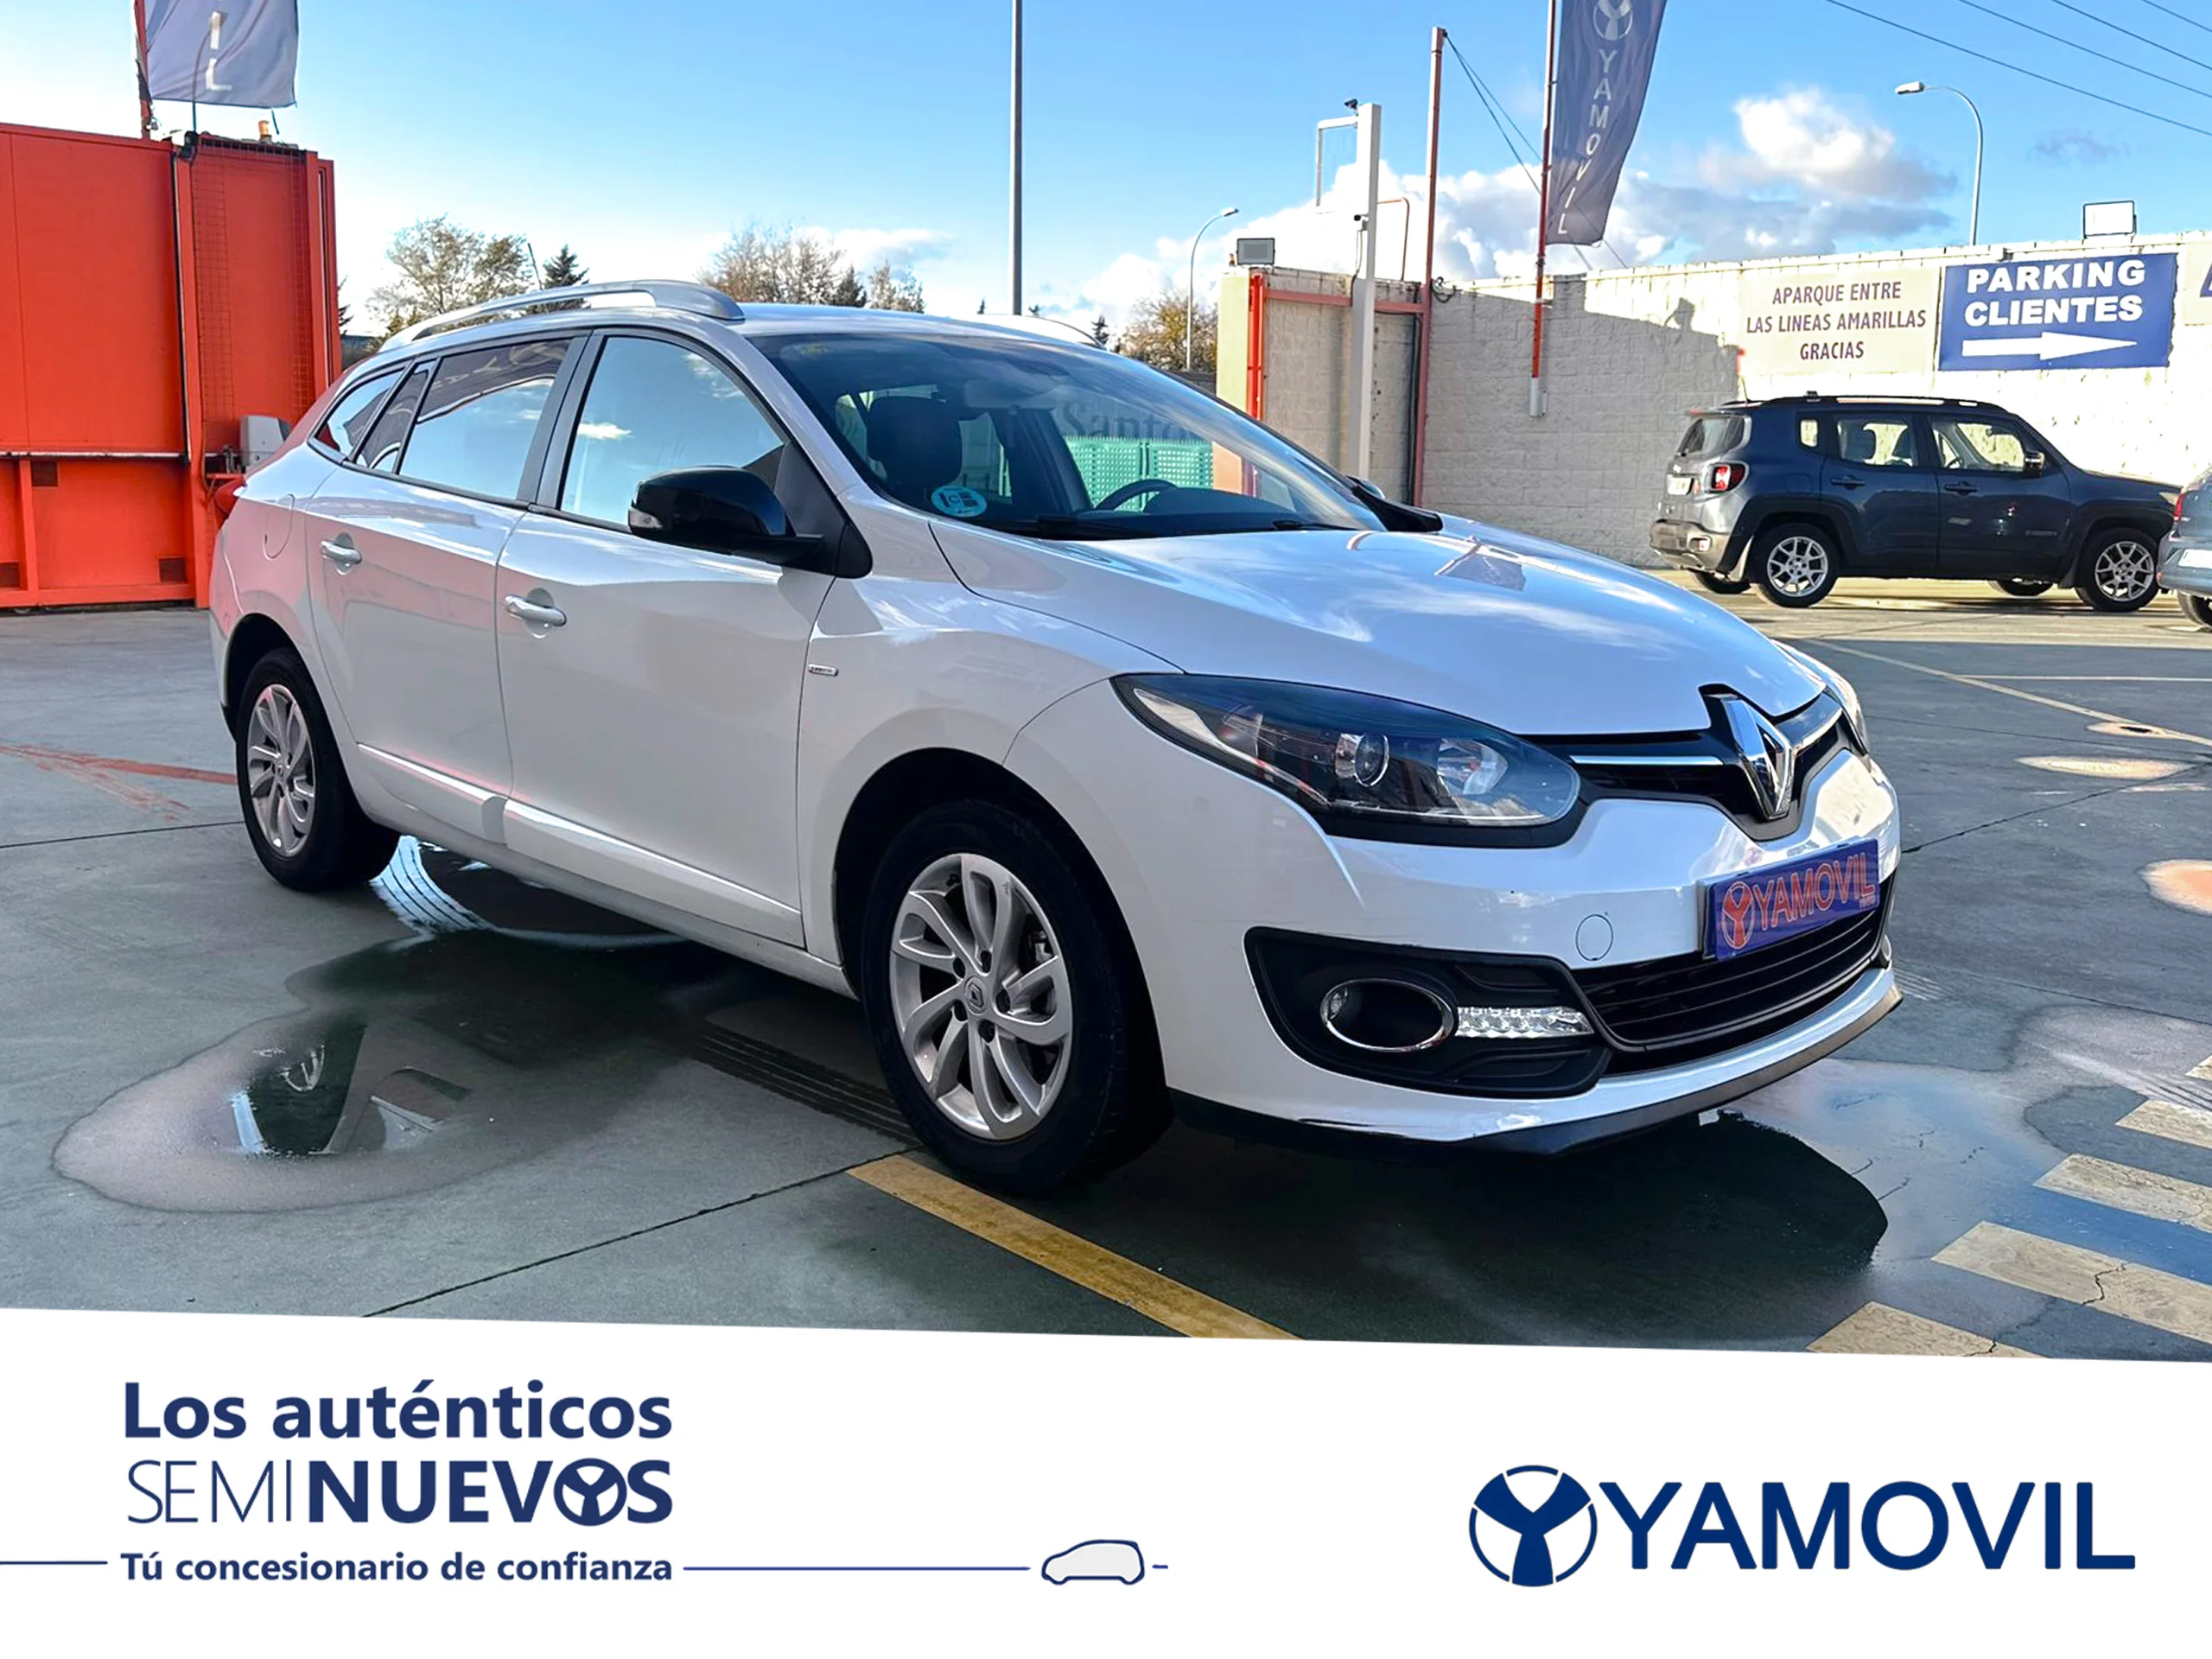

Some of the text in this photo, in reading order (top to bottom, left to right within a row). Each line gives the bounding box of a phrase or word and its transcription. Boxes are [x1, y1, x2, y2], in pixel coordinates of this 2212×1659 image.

[1556, 48, 1618, 235] YAMOVIL
[1967, 259, 2145, 294] PARKING
[1772, 281, 1902, 306] APARQUE ENTRE
[1746, 309, 1926, 334] LAS LINEAS AMARILLAS
[1964, 295, 2143, 327] CLIENTES
[1800, 340, 1864, 360] GRACIAS
[1752, 852, 1876, 931] YAMOVIL
